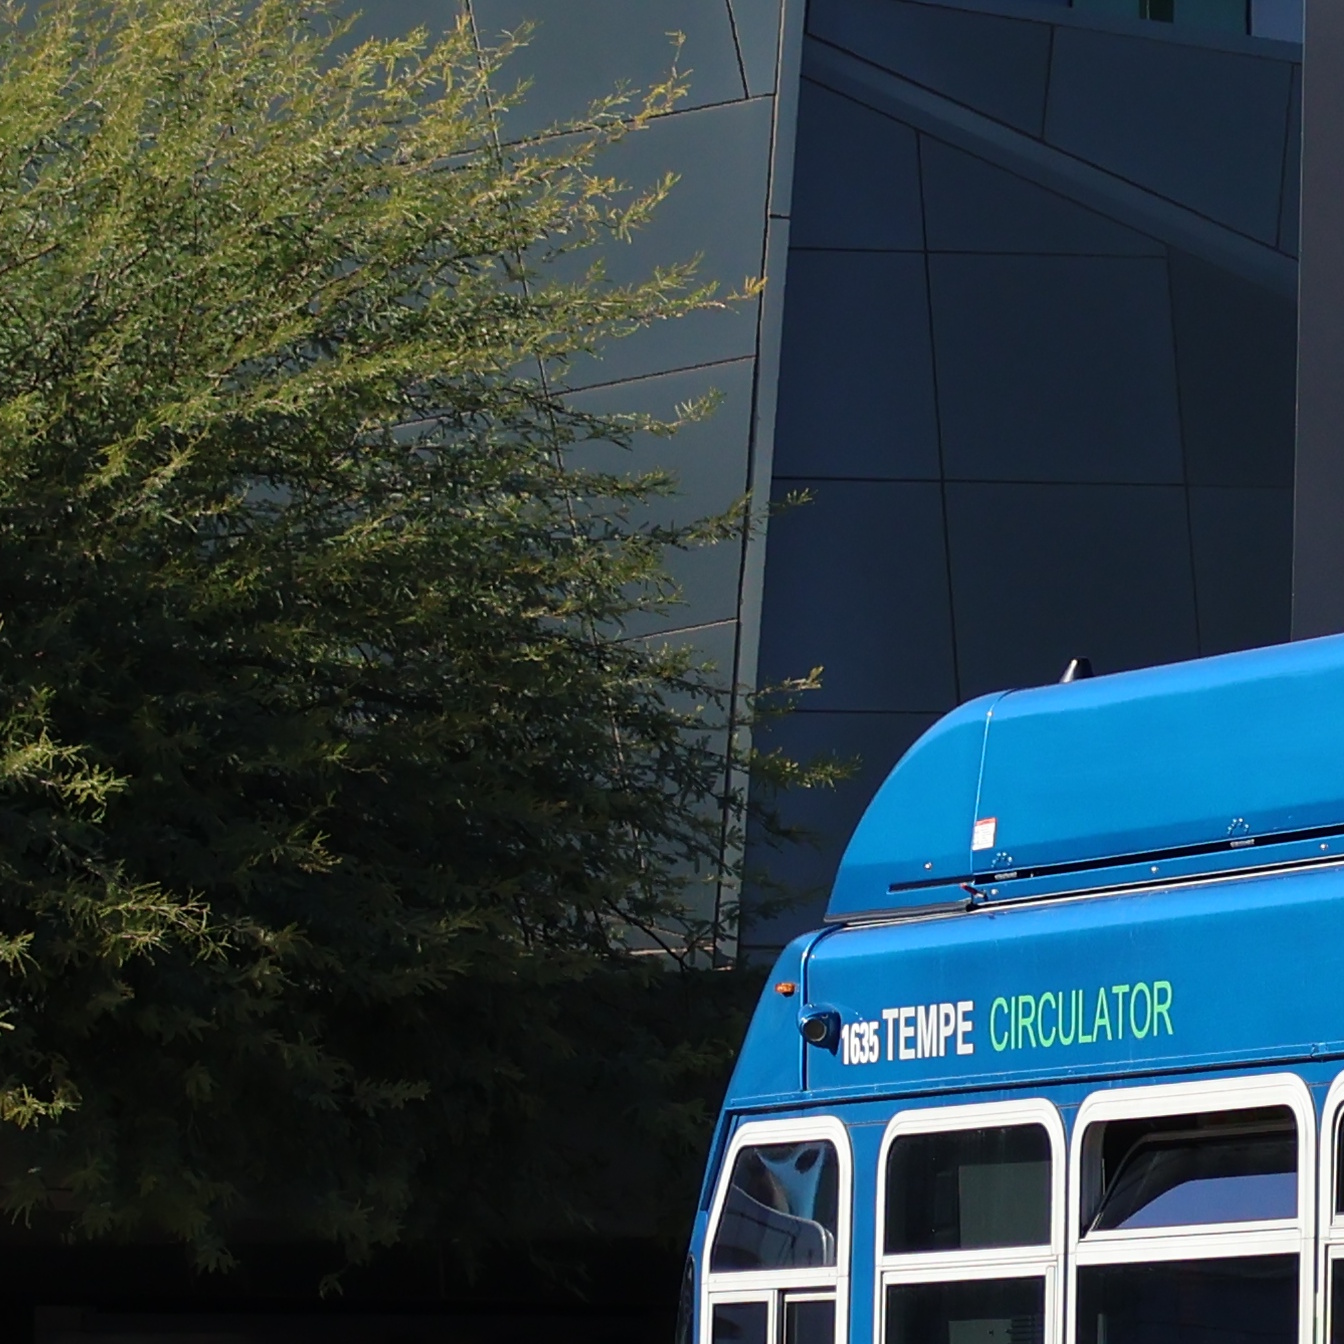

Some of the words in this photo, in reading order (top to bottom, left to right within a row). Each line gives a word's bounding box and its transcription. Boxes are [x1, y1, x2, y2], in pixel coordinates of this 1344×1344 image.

[841, 1020, 880, 1066] 1635
[881, 1000, 974, 1062] TEMPE
[989, 980, 1175, 1052] CIRCULATOR
